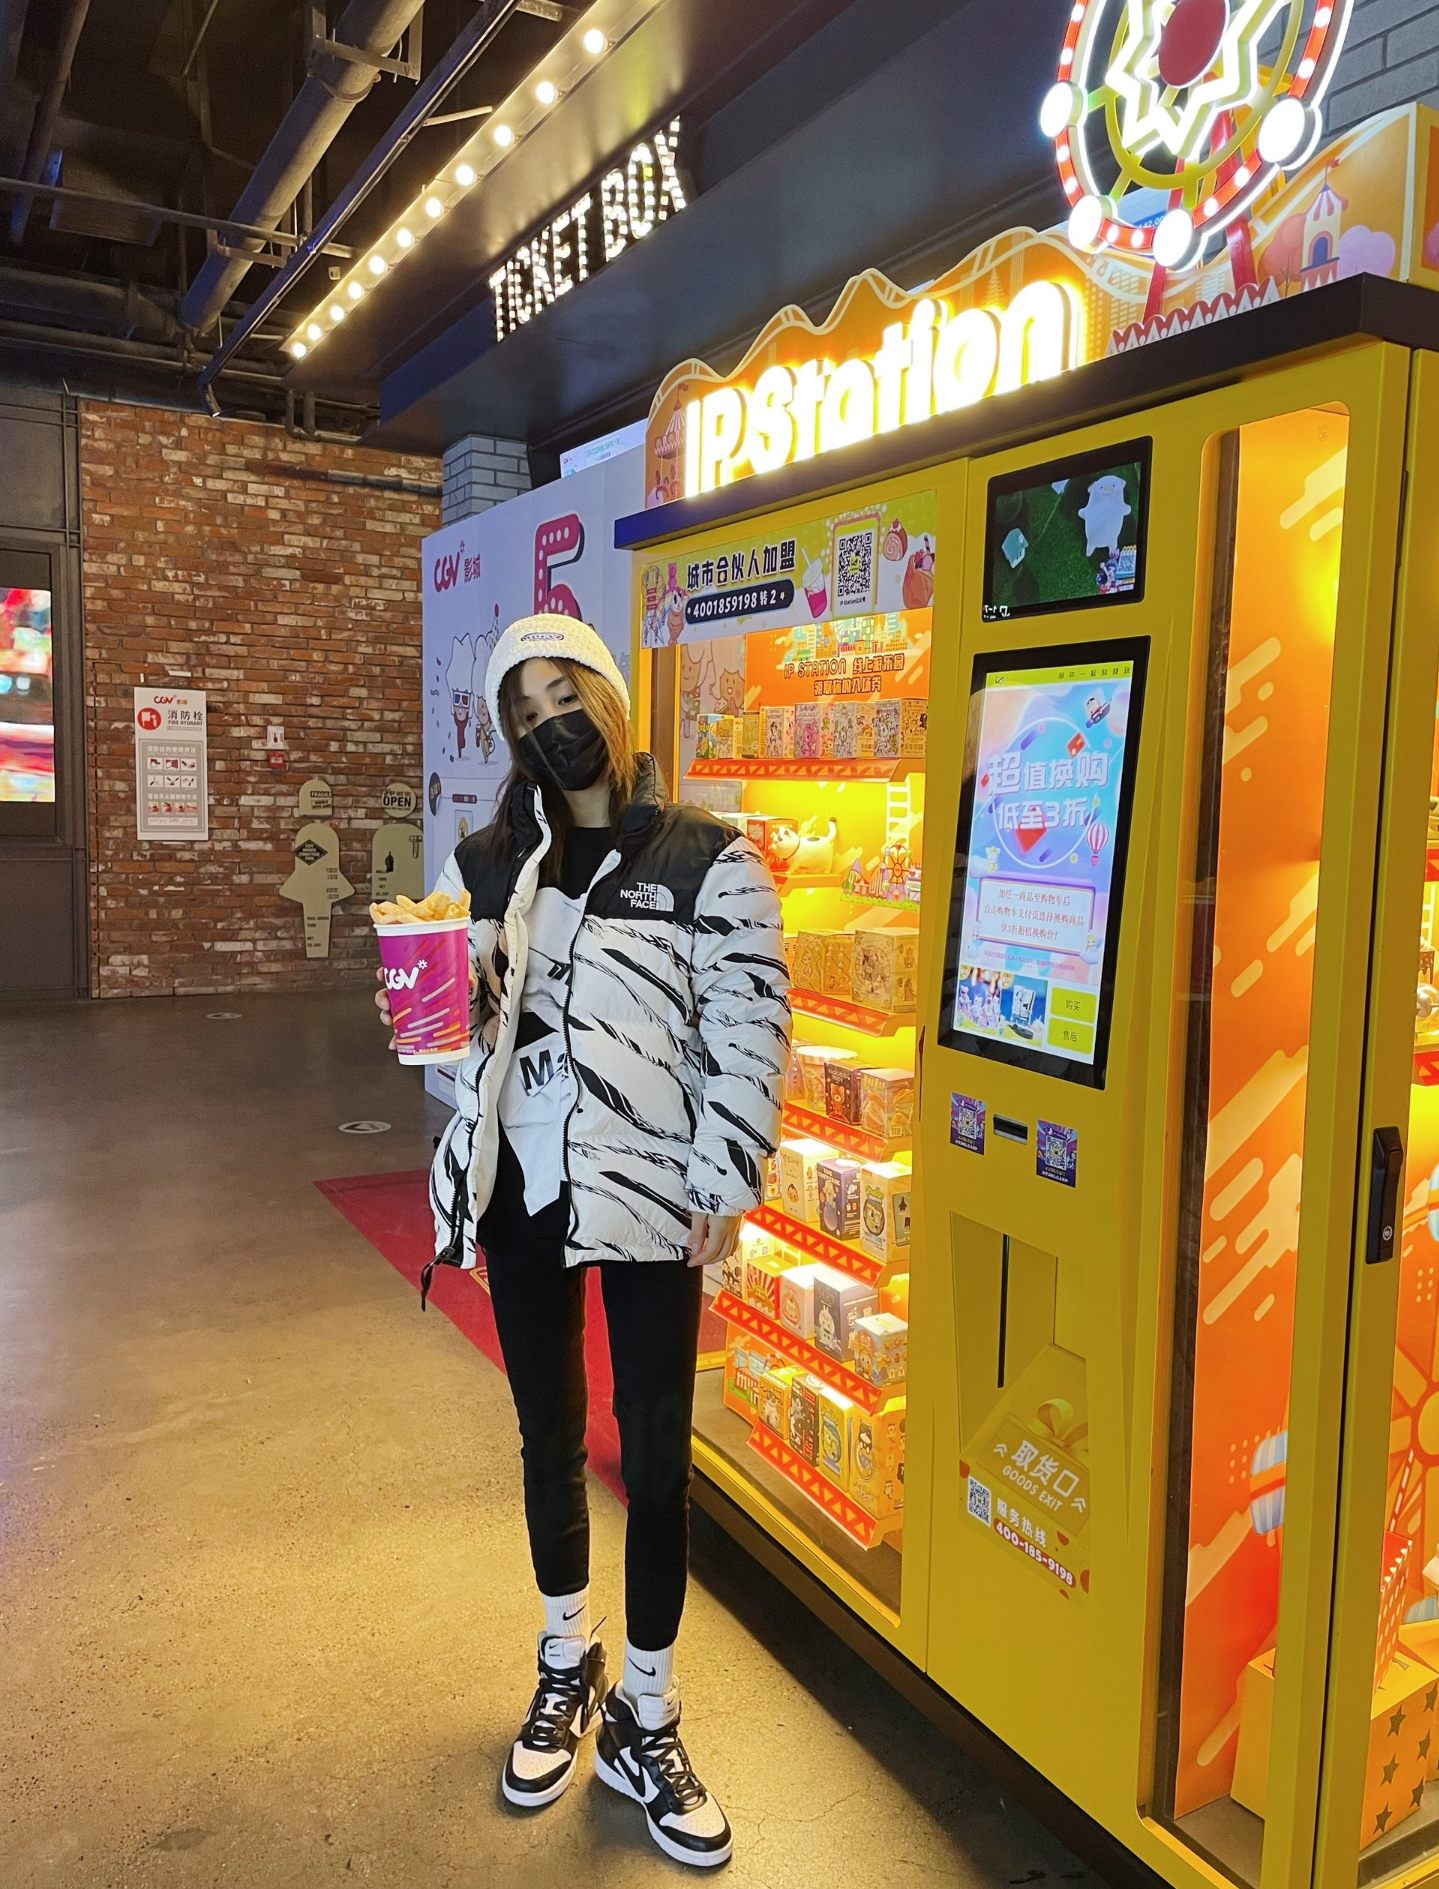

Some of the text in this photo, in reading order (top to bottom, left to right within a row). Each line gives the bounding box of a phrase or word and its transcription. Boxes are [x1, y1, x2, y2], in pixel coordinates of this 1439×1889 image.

[489, 115, 687, 342] TICKET BOX
[434, 552, 481, 593] CGV 影城
[687, 538, 796, 590] 城市合伙人加盟
[693, 592, 758, 619] 4001859198
[769, 590, 777, 605] 2
[784, 662, 795, 679] IP
[852, 652, 905, 675] 线上游乐园
[153, 695, 174, 705] CGV
[168, 709, 204, 721] 消防栓
[989, 751, 1110, 796] 超值换购
[383, 796, 412, 808] OPEN
[999, 797, 1089, 832] 低至3折
[620, 889, 657, 902] NORTH
[636, 882, 657, 893] THE
[630, 899, 657, 910] FACE
[1065, 999, 1081, 1011] 购买
[1063, 1030, 1078, 1043] 售后
[1010, 1439, 1080, 1499] 取货口
[1002, 1465, 1063, 1512] GOODS EXIT
[996, 1498, 1047, 1548] 服务热线
[995, 1521, 1074, 1586] 400-185-9198
